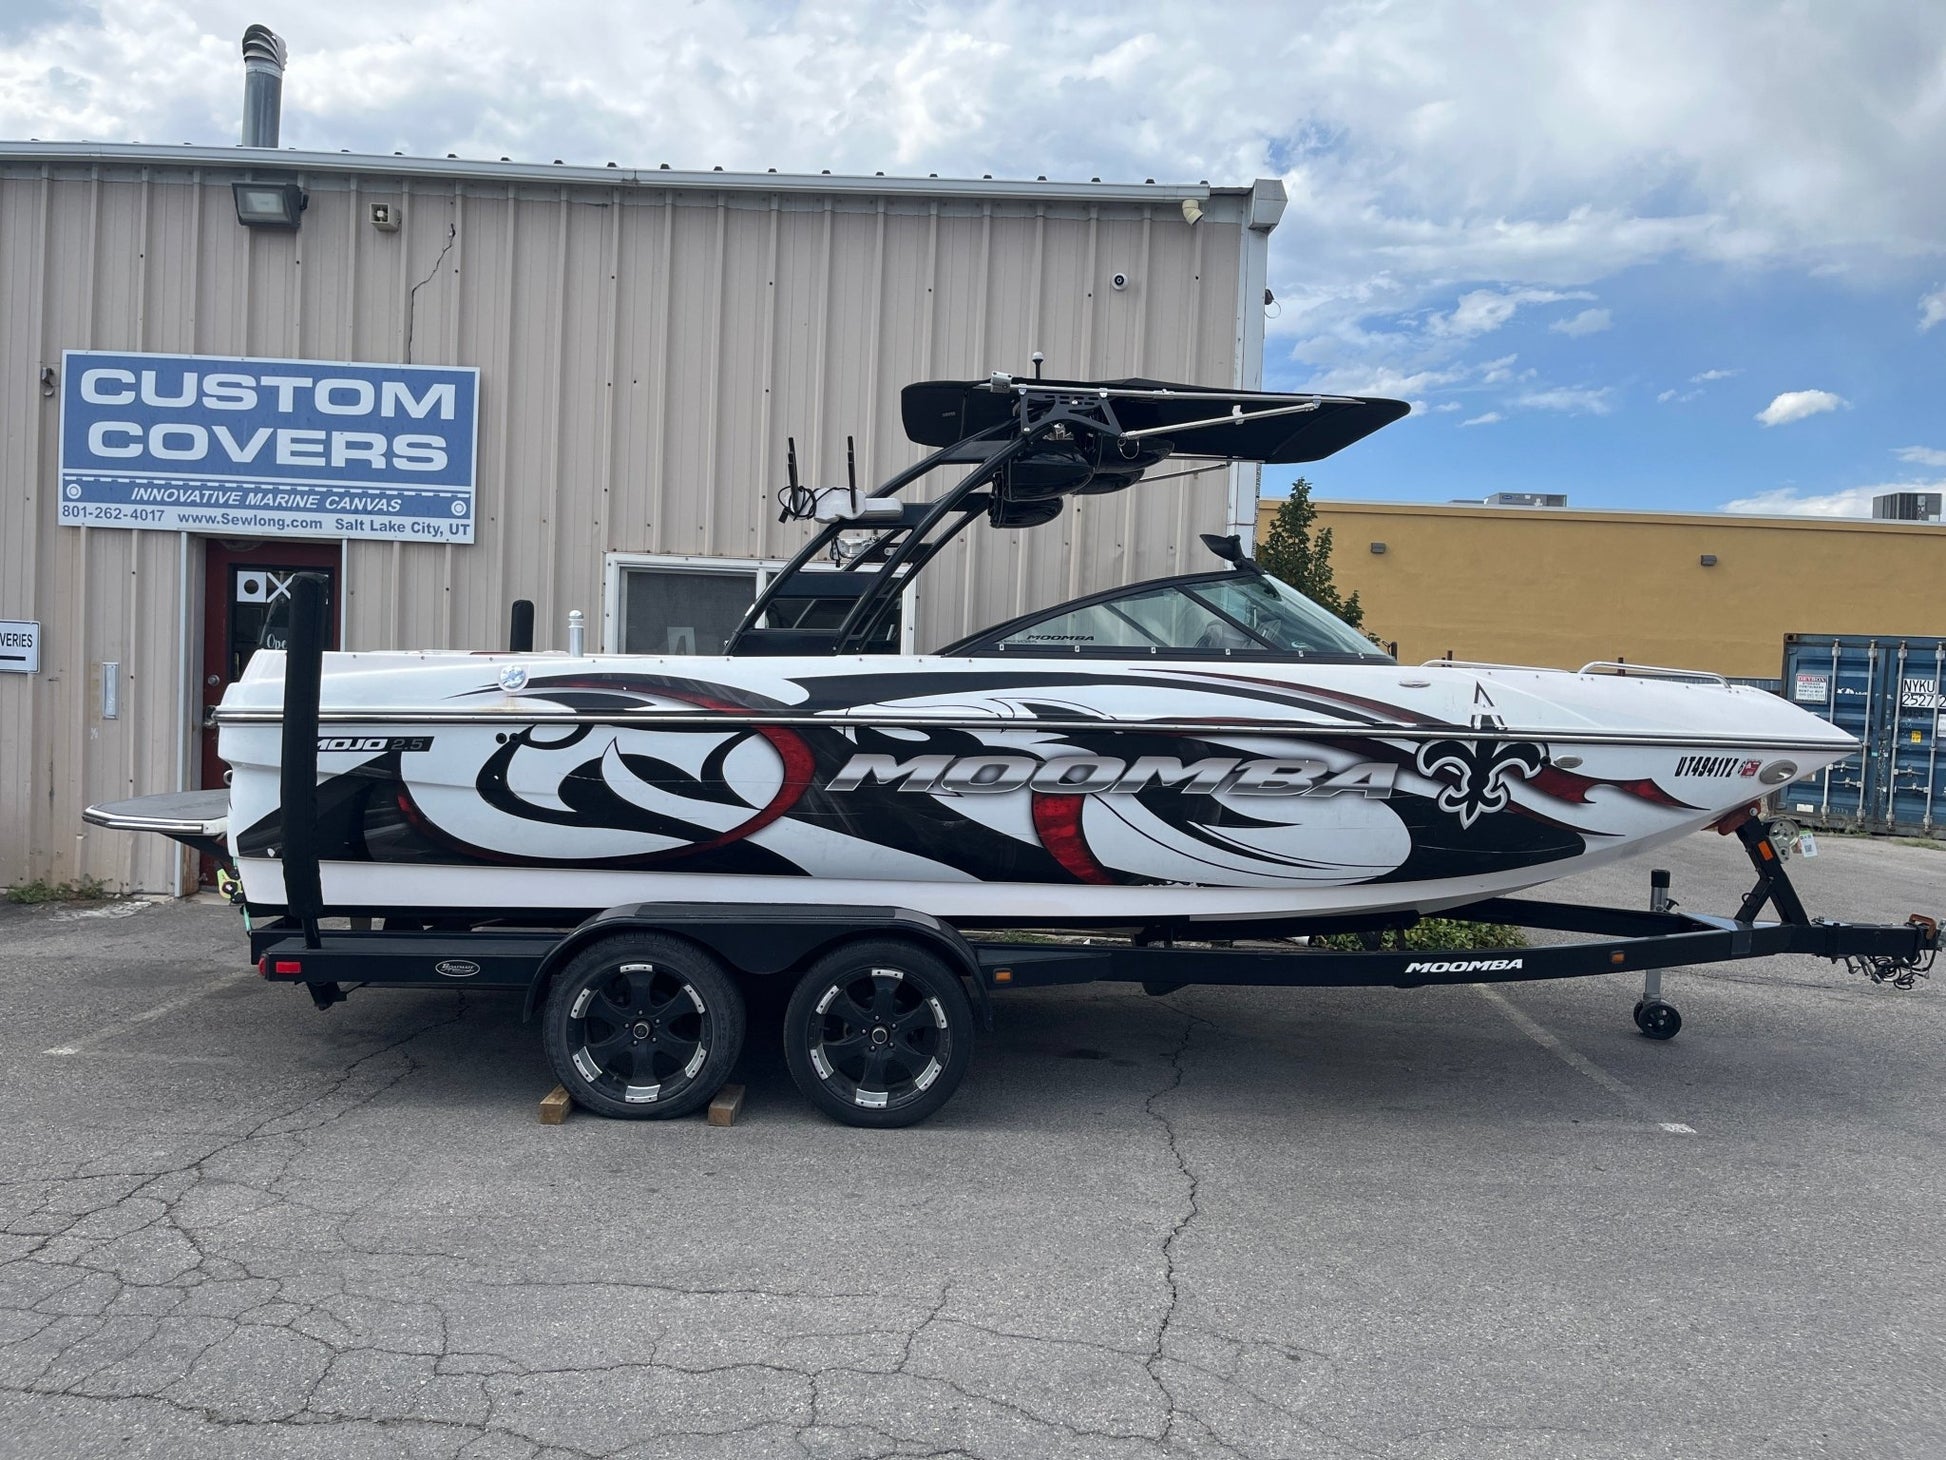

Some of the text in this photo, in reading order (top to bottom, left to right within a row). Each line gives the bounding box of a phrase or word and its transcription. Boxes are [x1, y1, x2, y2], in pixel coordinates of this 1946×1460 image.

[80, 368, 456, 420] CUSTOM
[87, 421, 449, 472] COVERS
[131, 487, 402, 512] INNOVATIVE MARINE CANVAS
[62, 505, 470, 538] 801-262-4017 www.Sewlong.com Salt Lake City, UT
[1903, 679, 1936, 693] NYKU
[391, 739, 425, 750] 2.5
[825, 753, 1399, 800] MOOMBA
[1404, 958, 1523, 973] MOOMBA
